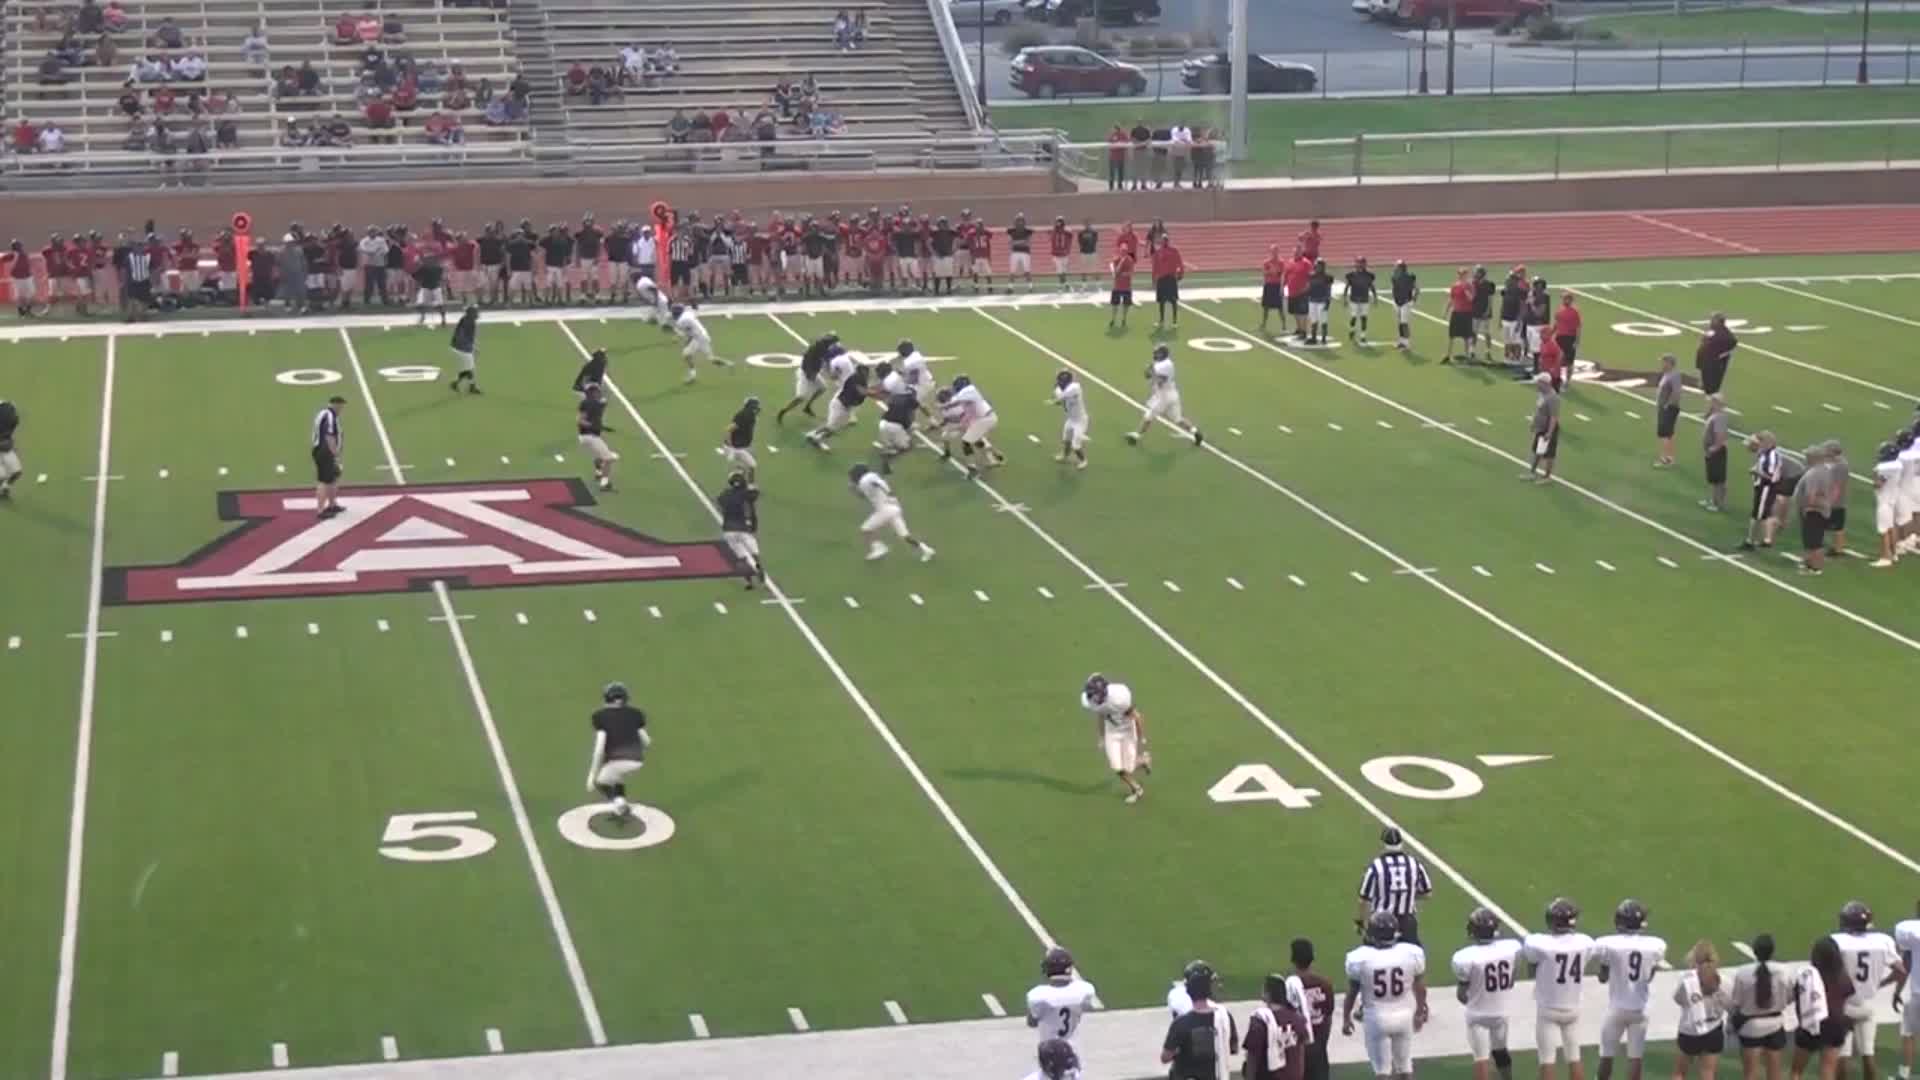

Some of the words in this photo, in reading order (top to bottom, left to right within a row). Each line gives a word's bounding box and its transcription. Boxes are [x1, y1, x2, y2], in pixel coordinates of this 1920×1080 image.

[124, 481, 735, 604] A
[1389, 866, 1408, 890] H
[1484, 960, 1510, 992] 66
[1556, 954, 1581, 984] 74
[1629, 951, 1643, 982] 9
[1856, 951, 1871, 983] 5
[1373, 967, 1404, 998] 56
[1058, 1007, 1071, 1037] 3
